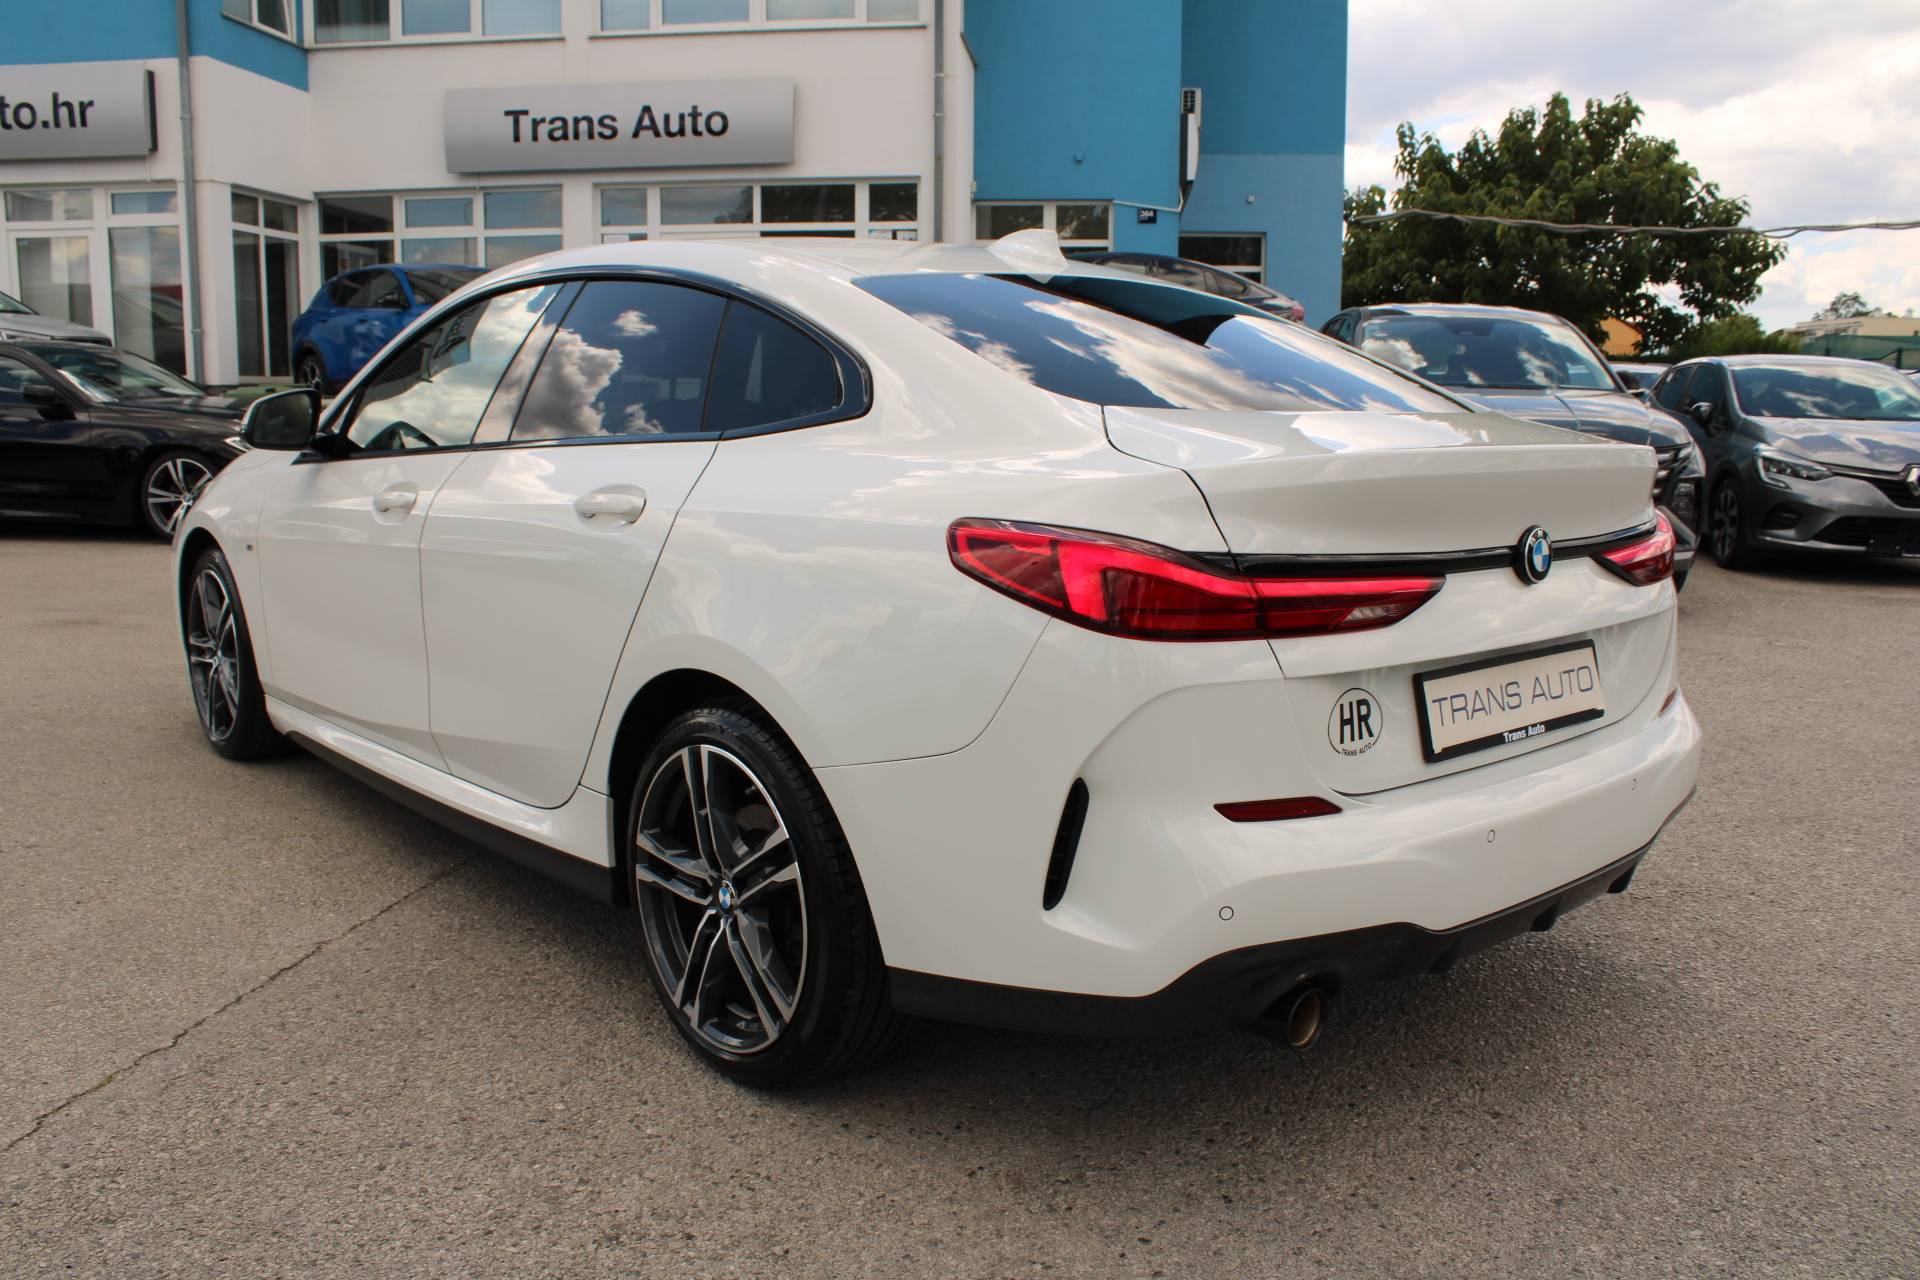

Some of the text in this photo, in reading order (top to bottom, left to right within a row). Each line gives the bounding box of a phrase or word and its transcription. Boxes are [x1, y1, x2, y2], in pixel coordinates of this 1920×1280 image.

[503, 104, 730, 143] Trans Auto
[1431, 665, 1594, 727] TRANS AUTO
[1339, 698, 1375, 745] HR
[1503, 723, 1546, 743] Trans Auto
[1341, 742, 1372, 757] TRANS AUTO
